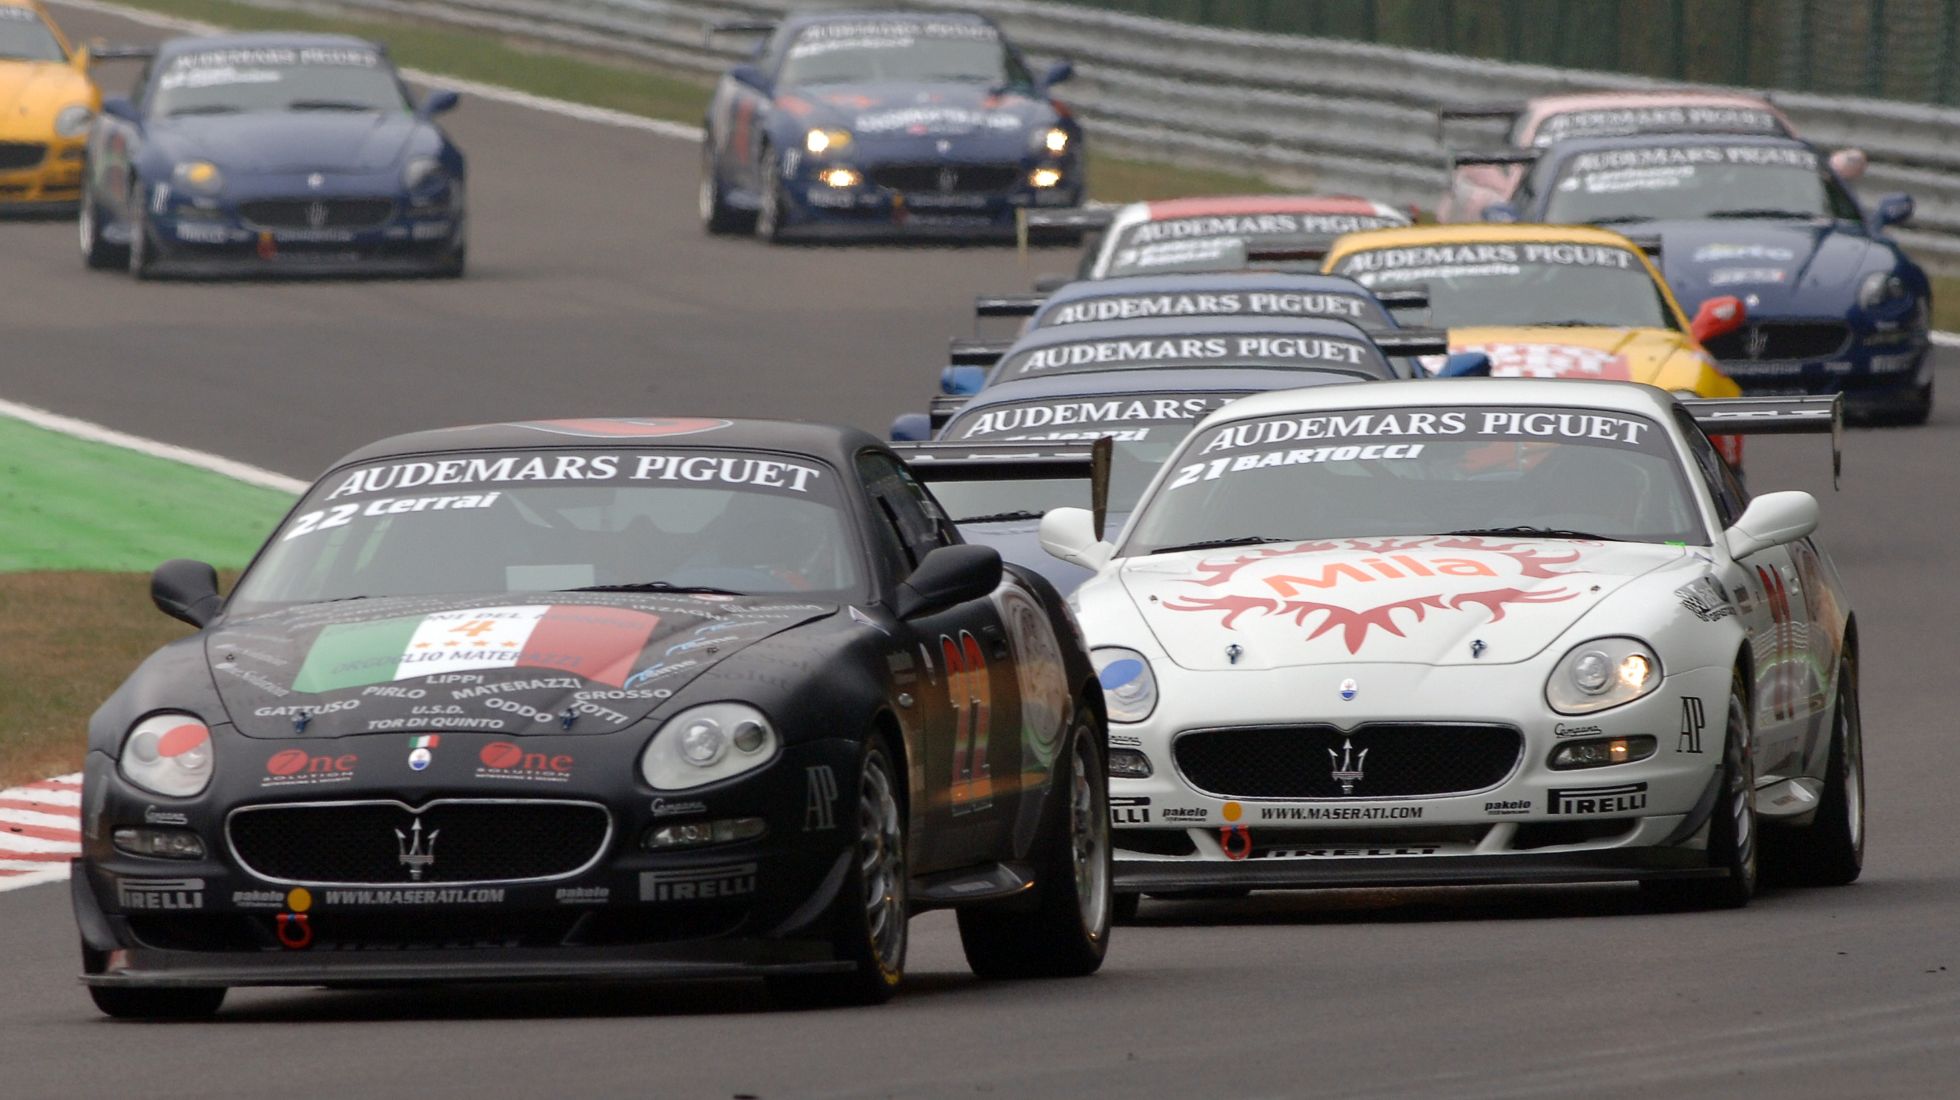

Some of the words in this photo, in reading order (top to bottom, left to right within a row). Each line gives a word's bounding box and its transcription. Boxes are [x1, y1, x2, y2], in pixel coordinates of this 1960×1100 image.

[1131, 214, 1298, 244] AUDEMARS
[1343, 244, 1518, 273] AUDEMARS
[1523, 244, 1633, 269] PIGUET
[1054, 293, 1242, 324] AUDEMARS
[1249, 293, 1366, 317] PIGUET
[1019, 336, 1228, 374] AUDEMARS
[1237, 337, 1366, 364] PIGUET
[961, 398, 1208, 439] AUDEMARS
[1199, 412, 1467, 455] AUDEMARS
[1478, 412, 1649, 445] PIGUET
[327, 455, 620, 500] AUDEMARS
[630, 455, 820, 492] PIGUET
[1169, 457, 1231, 491] 21
[1230, 444, 1424, 472] BARTOCCI
[284, 503, 359, 541] 22
[1262, 554, 1499, 598] Mila
[449, 620, 495, 637] 4
[362, 685, 427, 700] PIRLO
[426, 674, 485, 685] LIPPI
[451, 677, 582, 700] MATERAZZI
[573, 688, 672, 700] GROSSO
[254, 698, 361, 718] GATTUSO
[411, 705, 465, 715] U.S.D.
[485, 697, 554, 723] ODDO
[571, 700, 629, 725] TOTTI
[367, 718, 406, 730] TOR
[409, 718, 432, 729] DI
[433, 717, 505, 729] QUINTO
[1677, 695, 1706, 754] AP
[802, 764, 840, 832] AP
[1484, 799, 1531, 811] pakelo
[1547, 782, 1648, 815] PIRELLI
[1162, 807, 1208, 817] pakelo
[1261, 805, 1424, 819] WWW.MASERATI.COM
[116, 878, 205, 909] PIRELLI
[556, 887, 610, 899] pakelo
[639, 863, 758, 901] PIRELLI
[325, 889, 505, 904] WWW.MASERATI.COM
